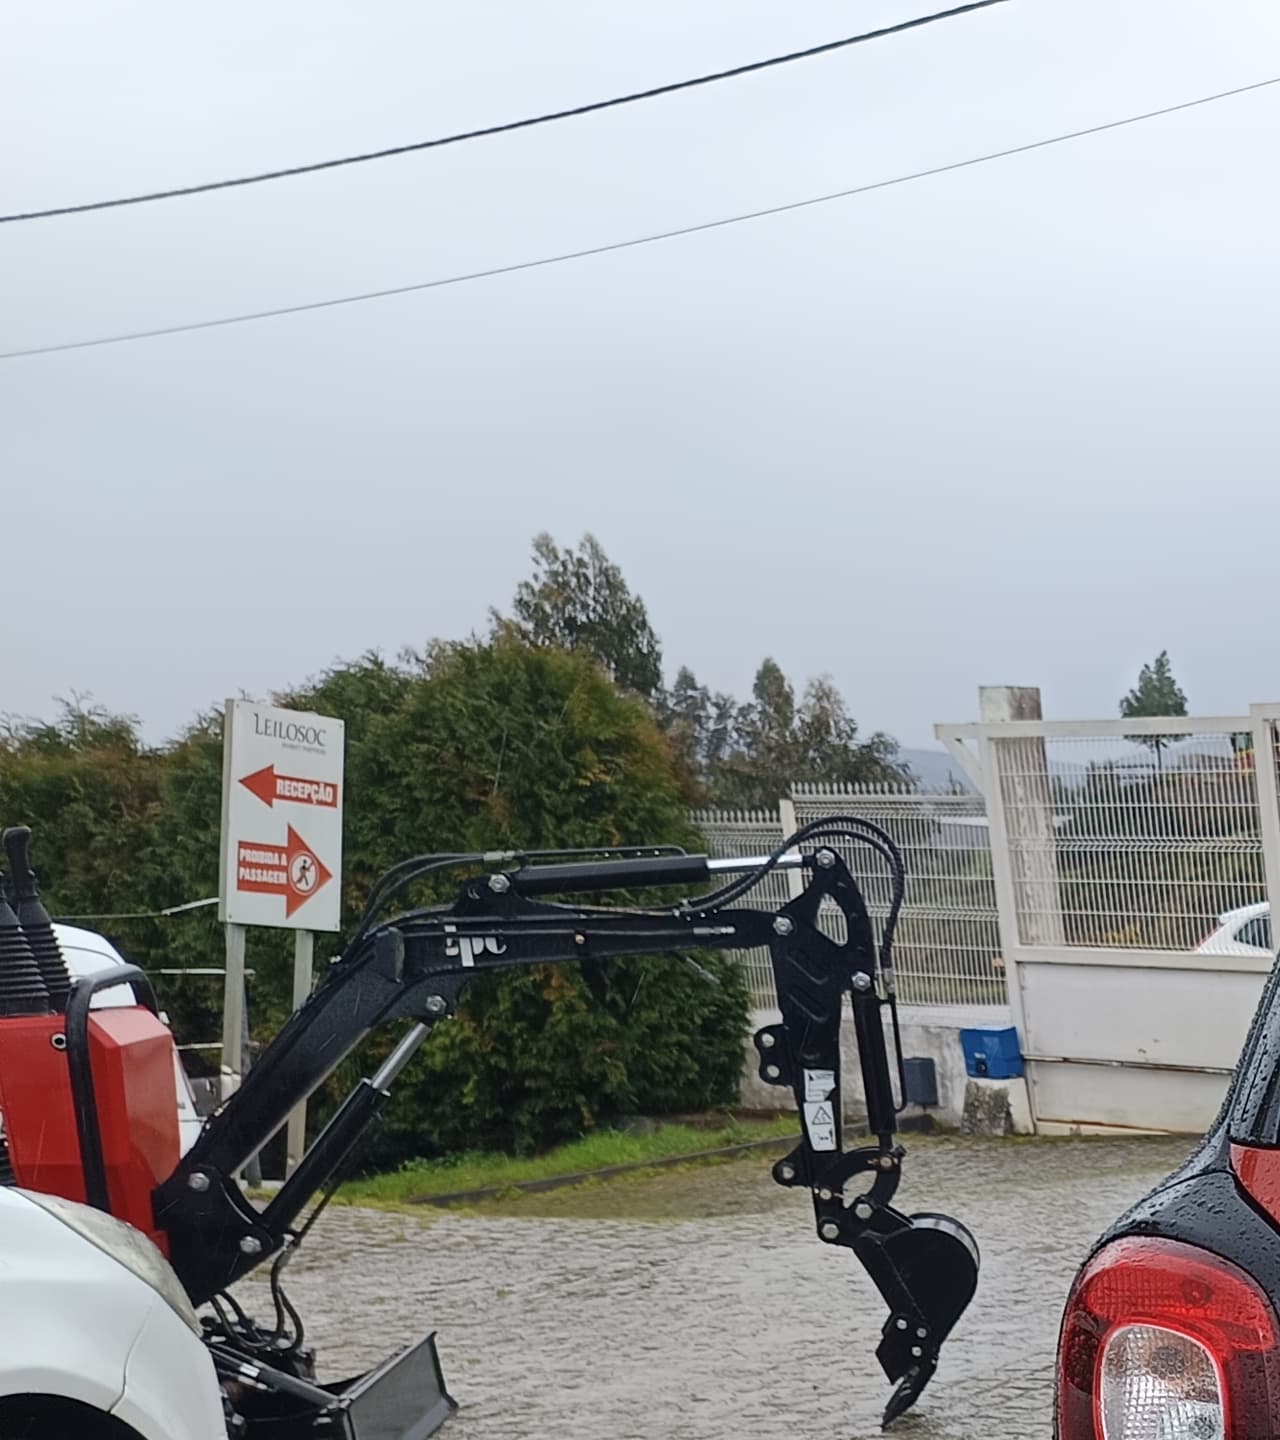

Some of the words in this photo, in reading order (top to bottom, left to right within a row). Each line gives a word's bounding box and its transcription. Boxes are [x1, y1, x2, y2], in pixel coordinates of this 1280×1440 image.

[253, 712, 327, 747] LEILOSOC
[276, 778, 333, 805] RECEPÇÃO
[281, 852, 288, 866] A
[239, 866, 288, 885] PASSAGEM
